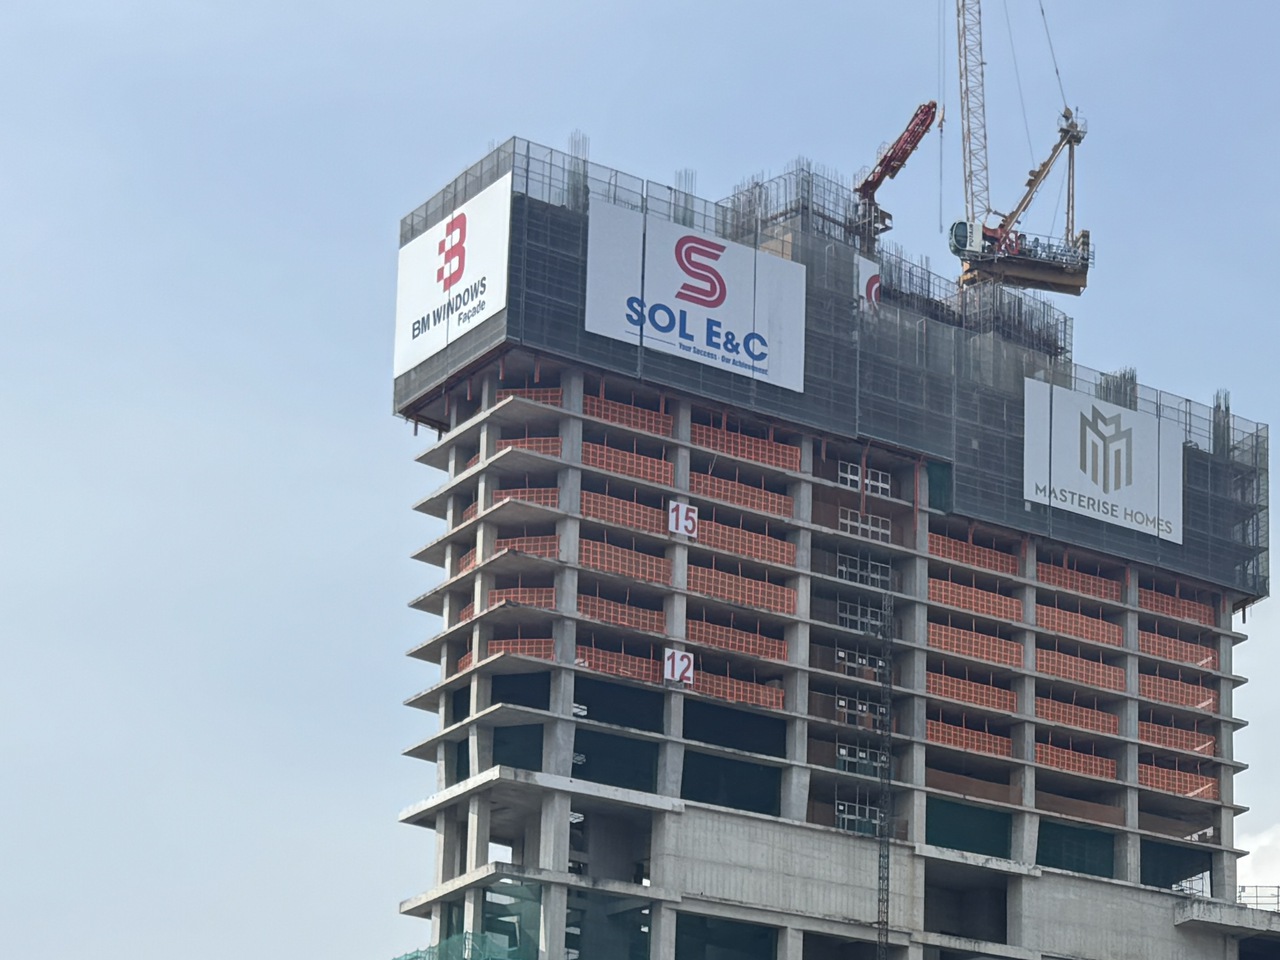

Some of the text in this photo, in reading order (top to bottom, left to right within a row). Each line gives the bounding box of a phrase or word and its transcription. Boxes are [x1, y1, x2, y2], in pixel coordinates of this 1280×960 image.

[412, 276, 487, 340] BM WINDOWS
[458, 299, 486, 326] Façade
[625, 296, 769, 361] SOL E&C
[671, 504, 697, 534] 15
[1035, 482, 1173, 534] MASTERISE HOMES
[667, 651, 692, 682] 12
